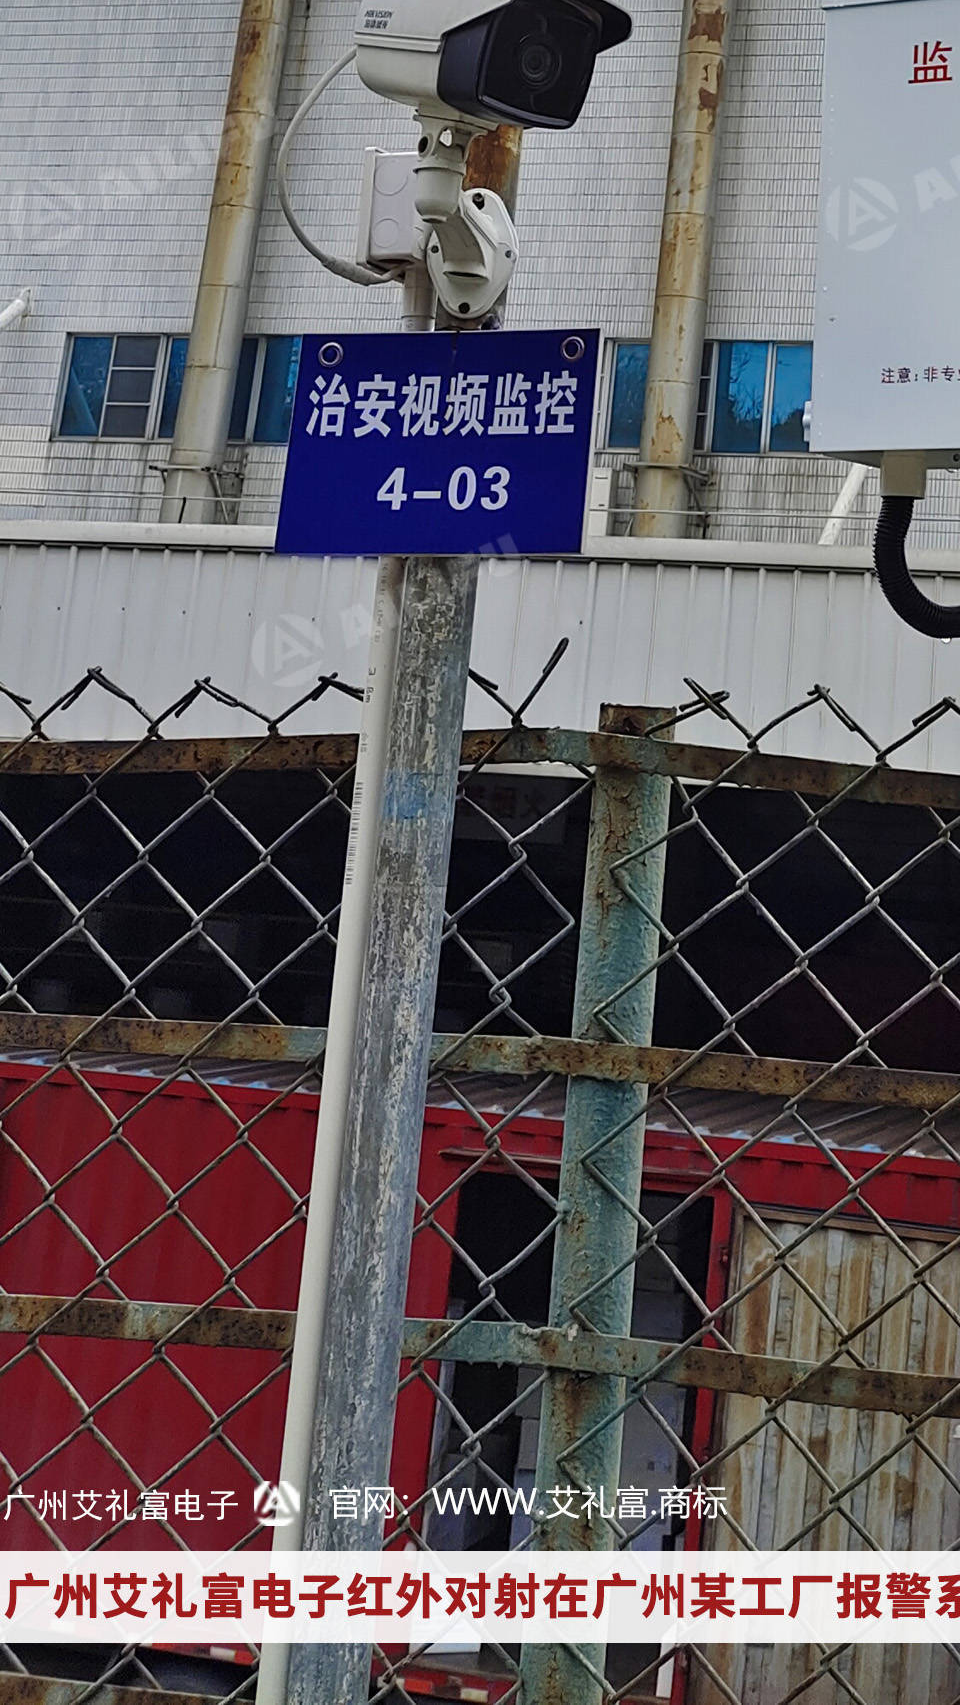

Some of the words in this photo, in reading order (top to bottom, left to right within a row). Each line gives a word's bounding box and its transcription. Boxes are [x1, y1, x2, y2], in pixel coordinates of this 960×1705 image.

[306, 371, 578, 436] 治安视频监控
[376, 466, 510, 511] 4-03
